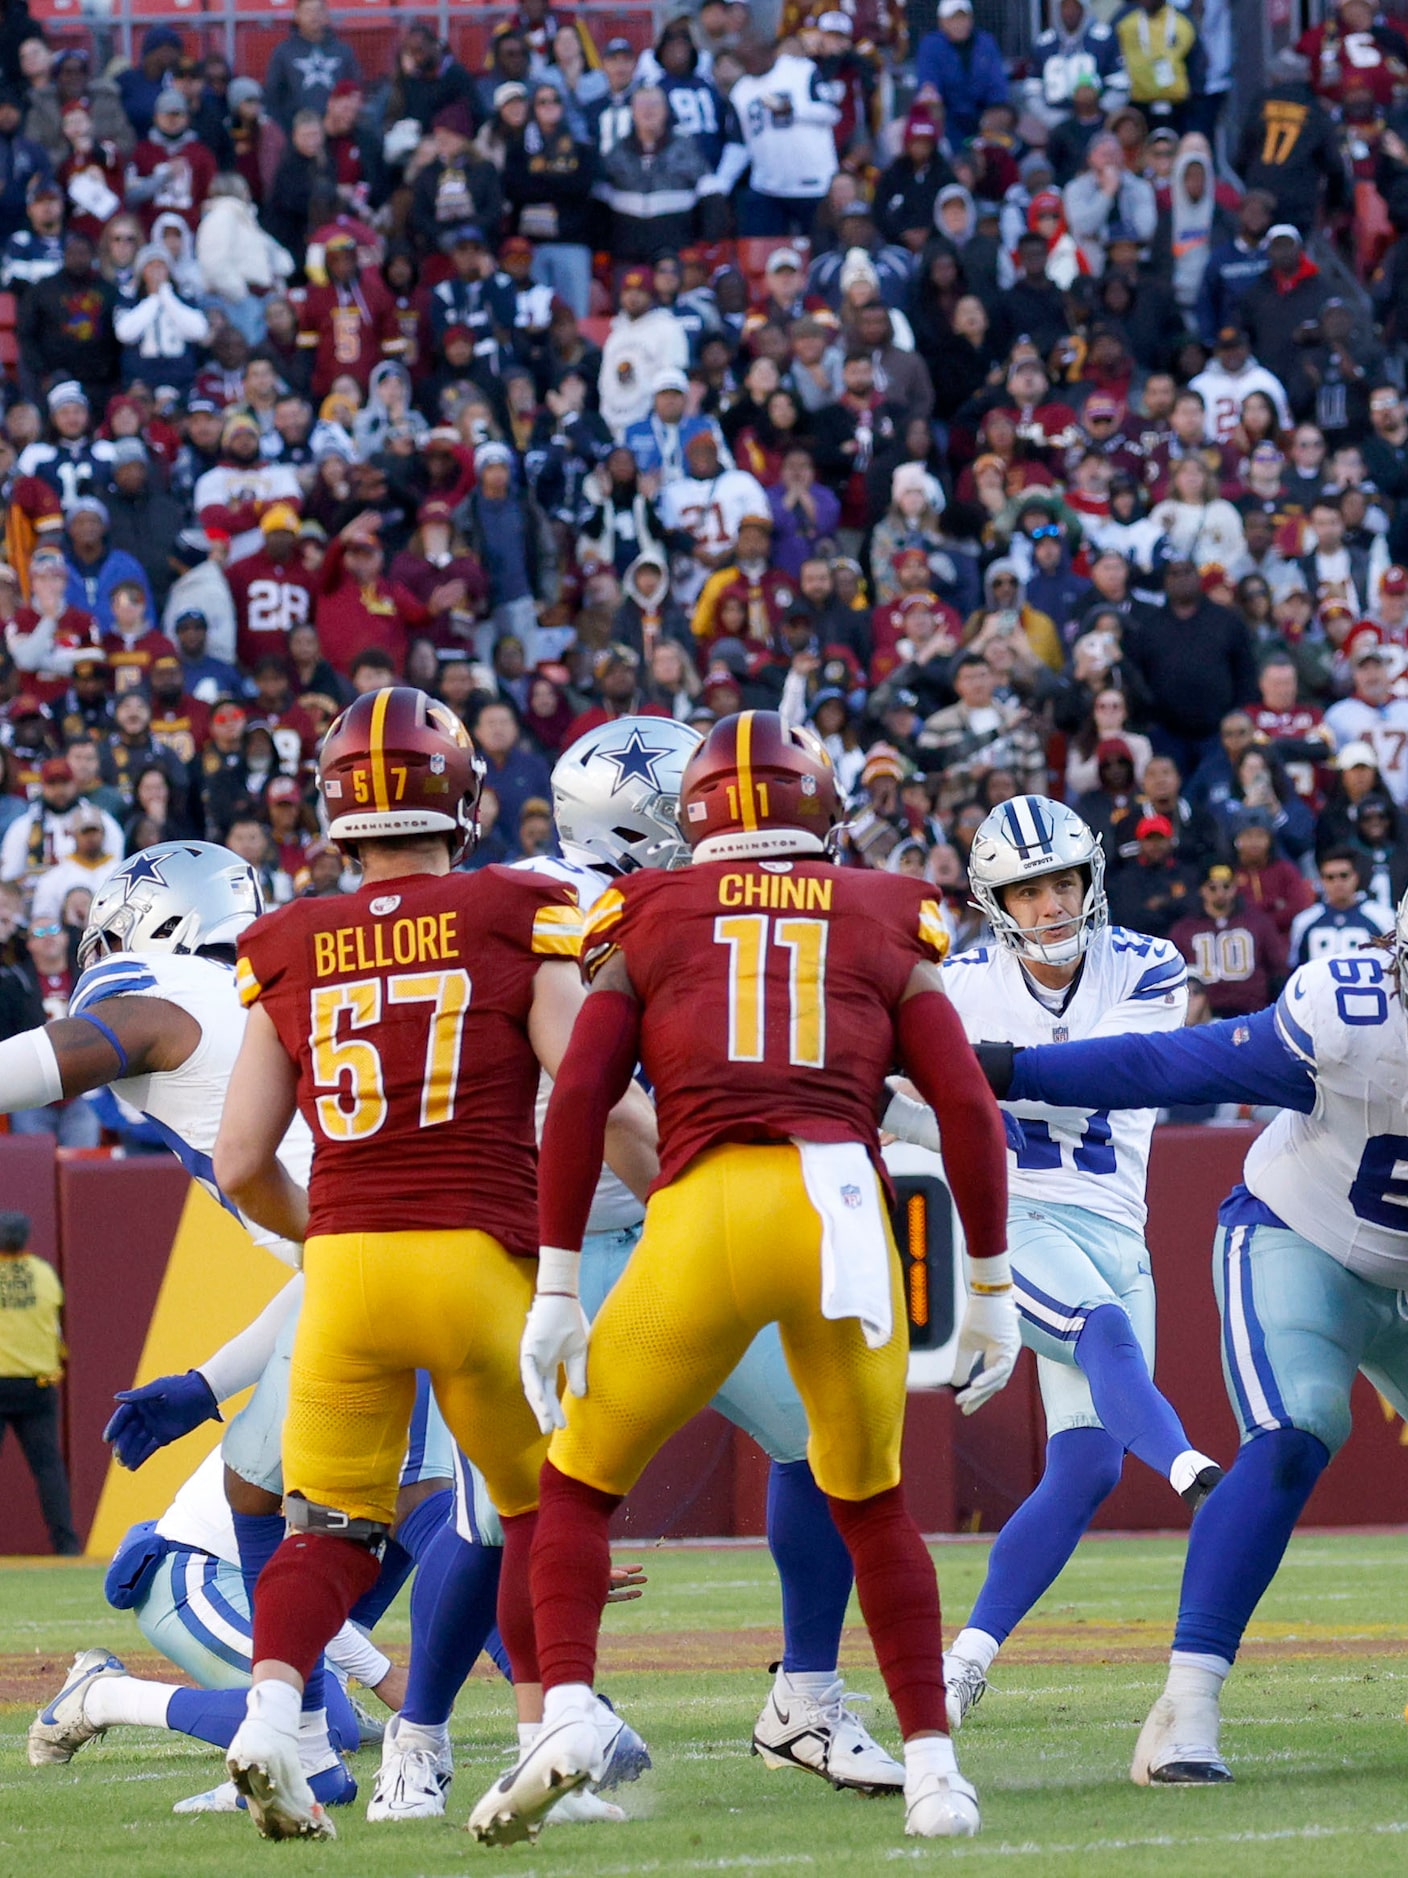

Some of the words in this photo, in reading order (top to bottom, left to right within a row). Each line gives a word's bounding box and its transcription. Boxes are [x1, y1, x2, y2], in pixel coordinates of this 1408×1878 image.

[670, 87, 720, 136] 91
[1261, 120, 1303, 165] 17
[345, 819, 428, 831] WASHINGTON
[710, 839, 797, 854] WASHINGTON
[1024, 856, 1054, 870] COWBOYS
[719, 873, 832, 911] CHINN
[313, 911, 459, 977] BELLORE
[1191, 928, 1255, 985] 10
[713, 913, 828, 1068] 11
[1327, 956, 1388, 1026] 60
[308, 968, 472, 1141] 57
